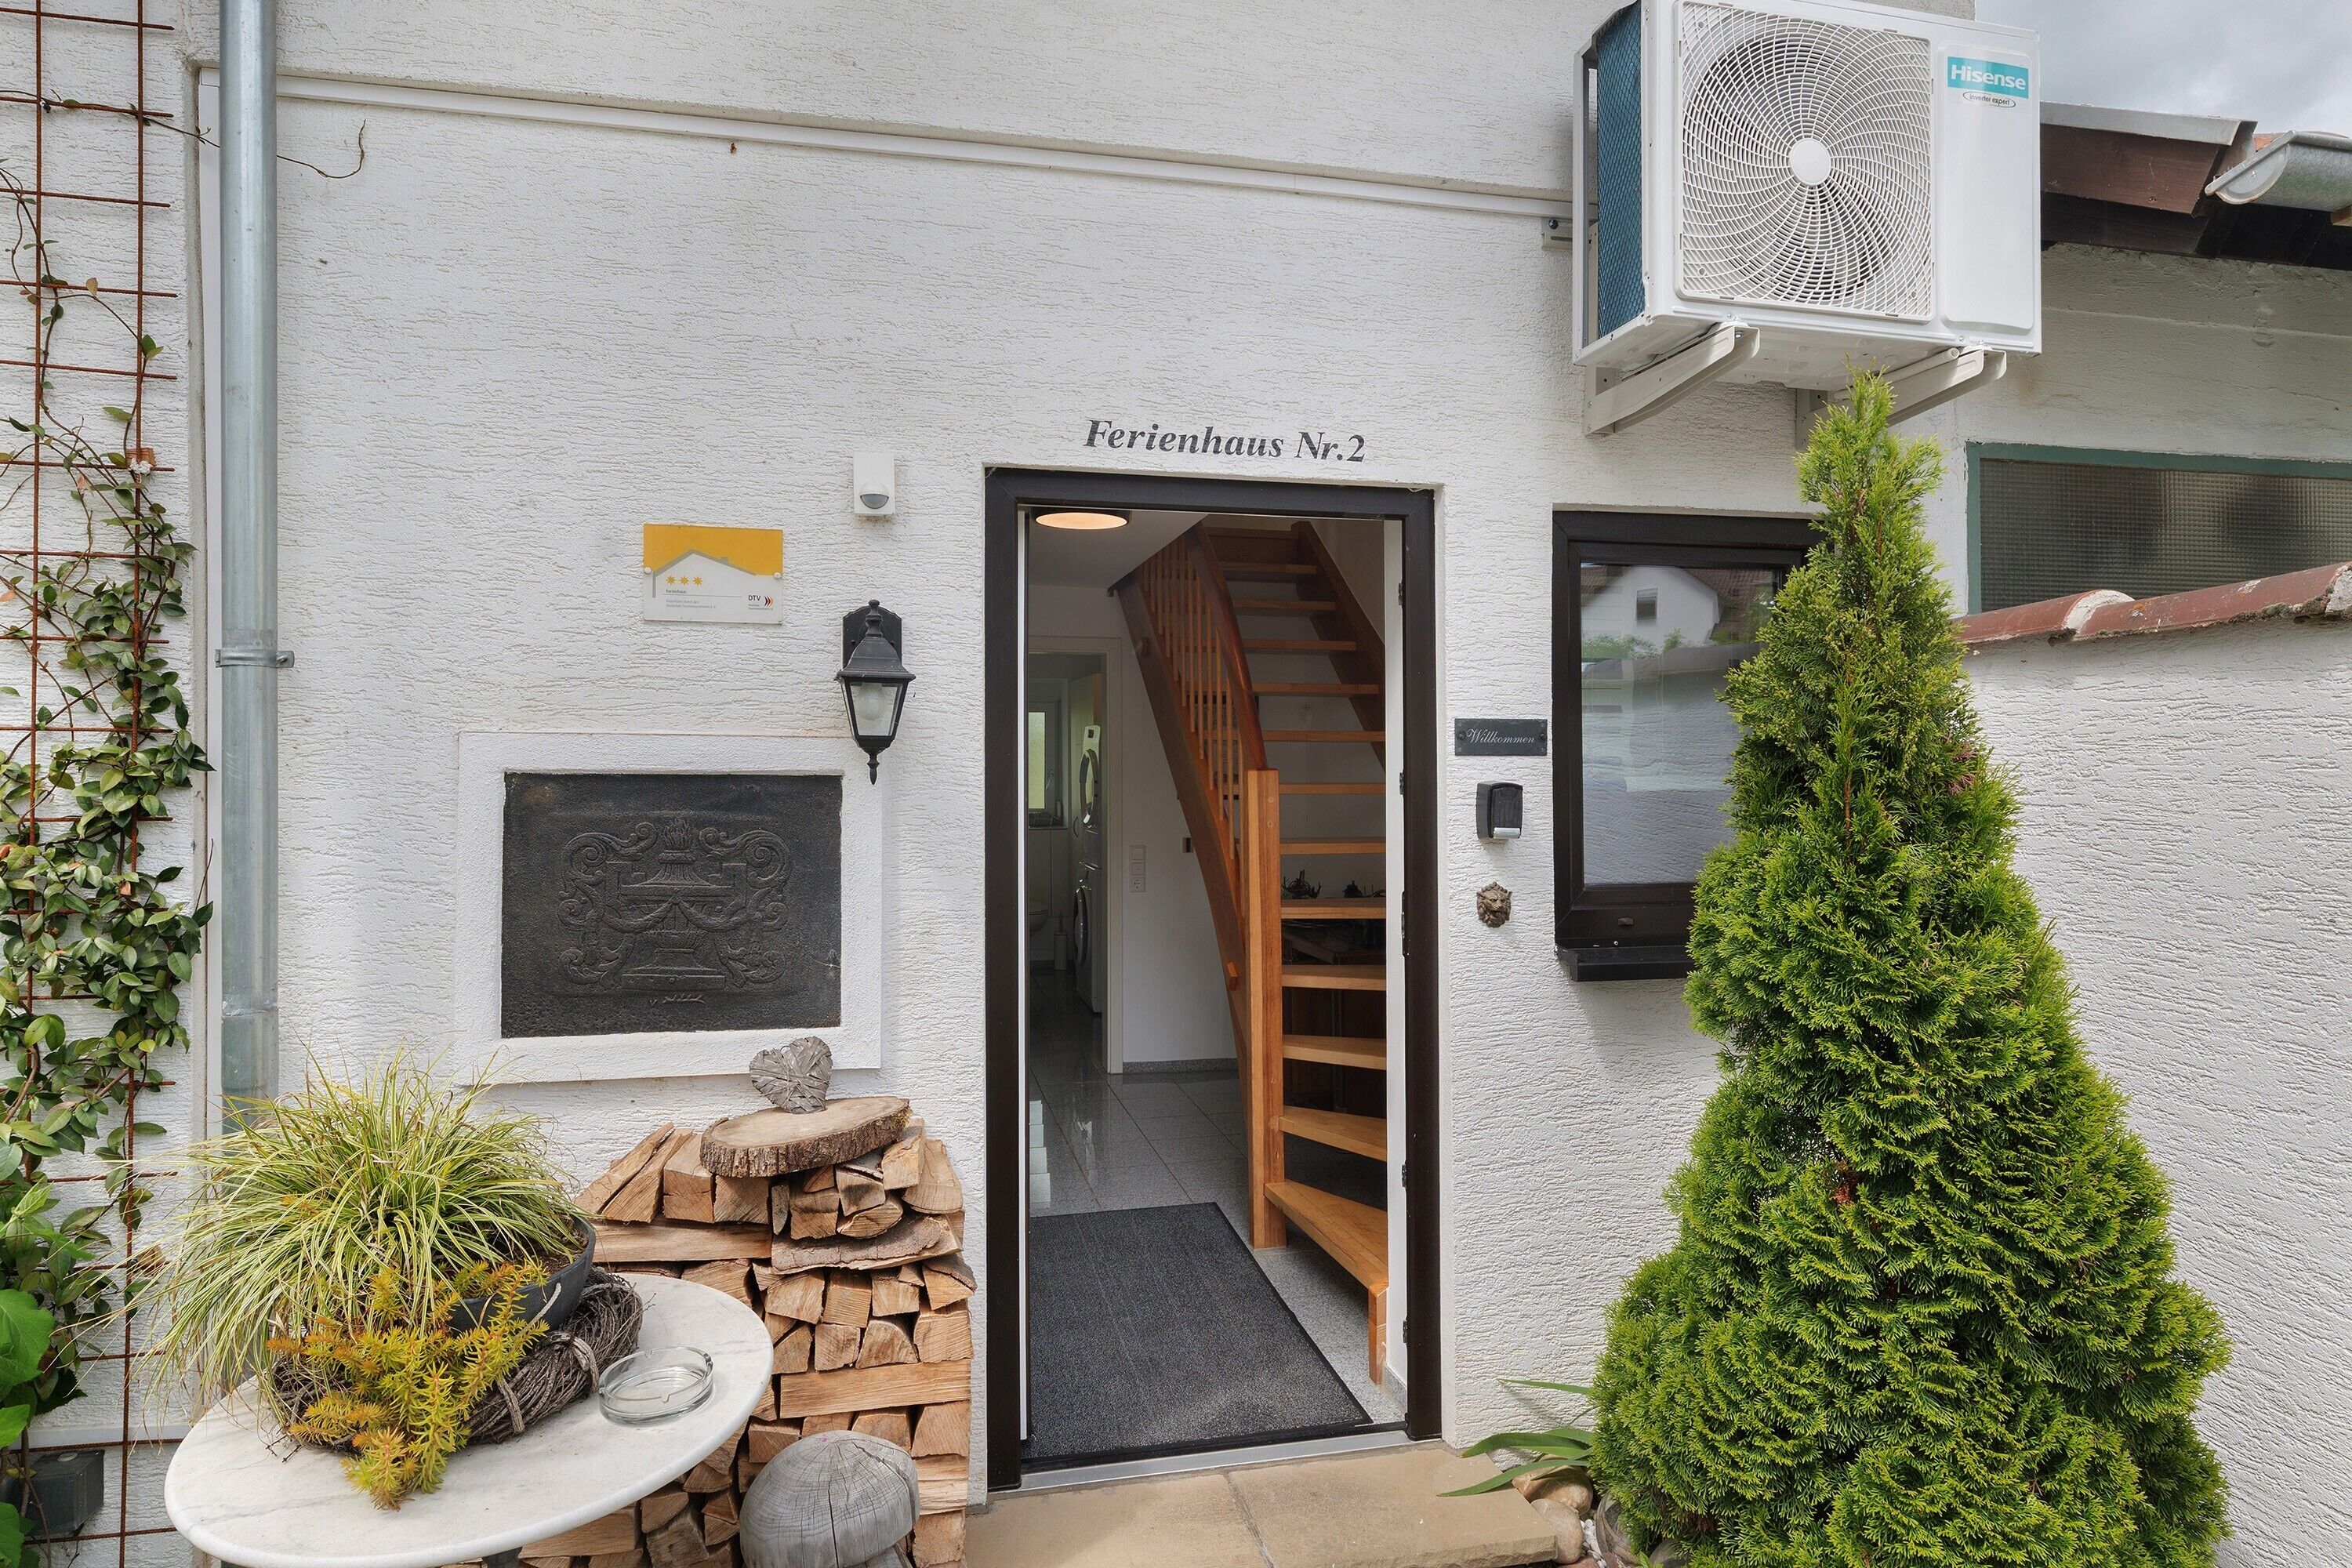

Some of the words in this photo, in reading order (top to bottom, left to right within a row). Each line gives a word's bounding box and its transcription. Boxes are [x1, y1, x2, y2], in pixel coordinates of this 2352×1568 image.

[1951, 64, 2026, 89] Hisense
[1969, 93, 1991, 103] inverter
[1992, 98, 2010, 107] expert
[1083, 419, 1284, 458] Ferienhaus
[1294, 431, 1366, 463] Nr.2
[1465, 729, 1535, 744] Willkommen
